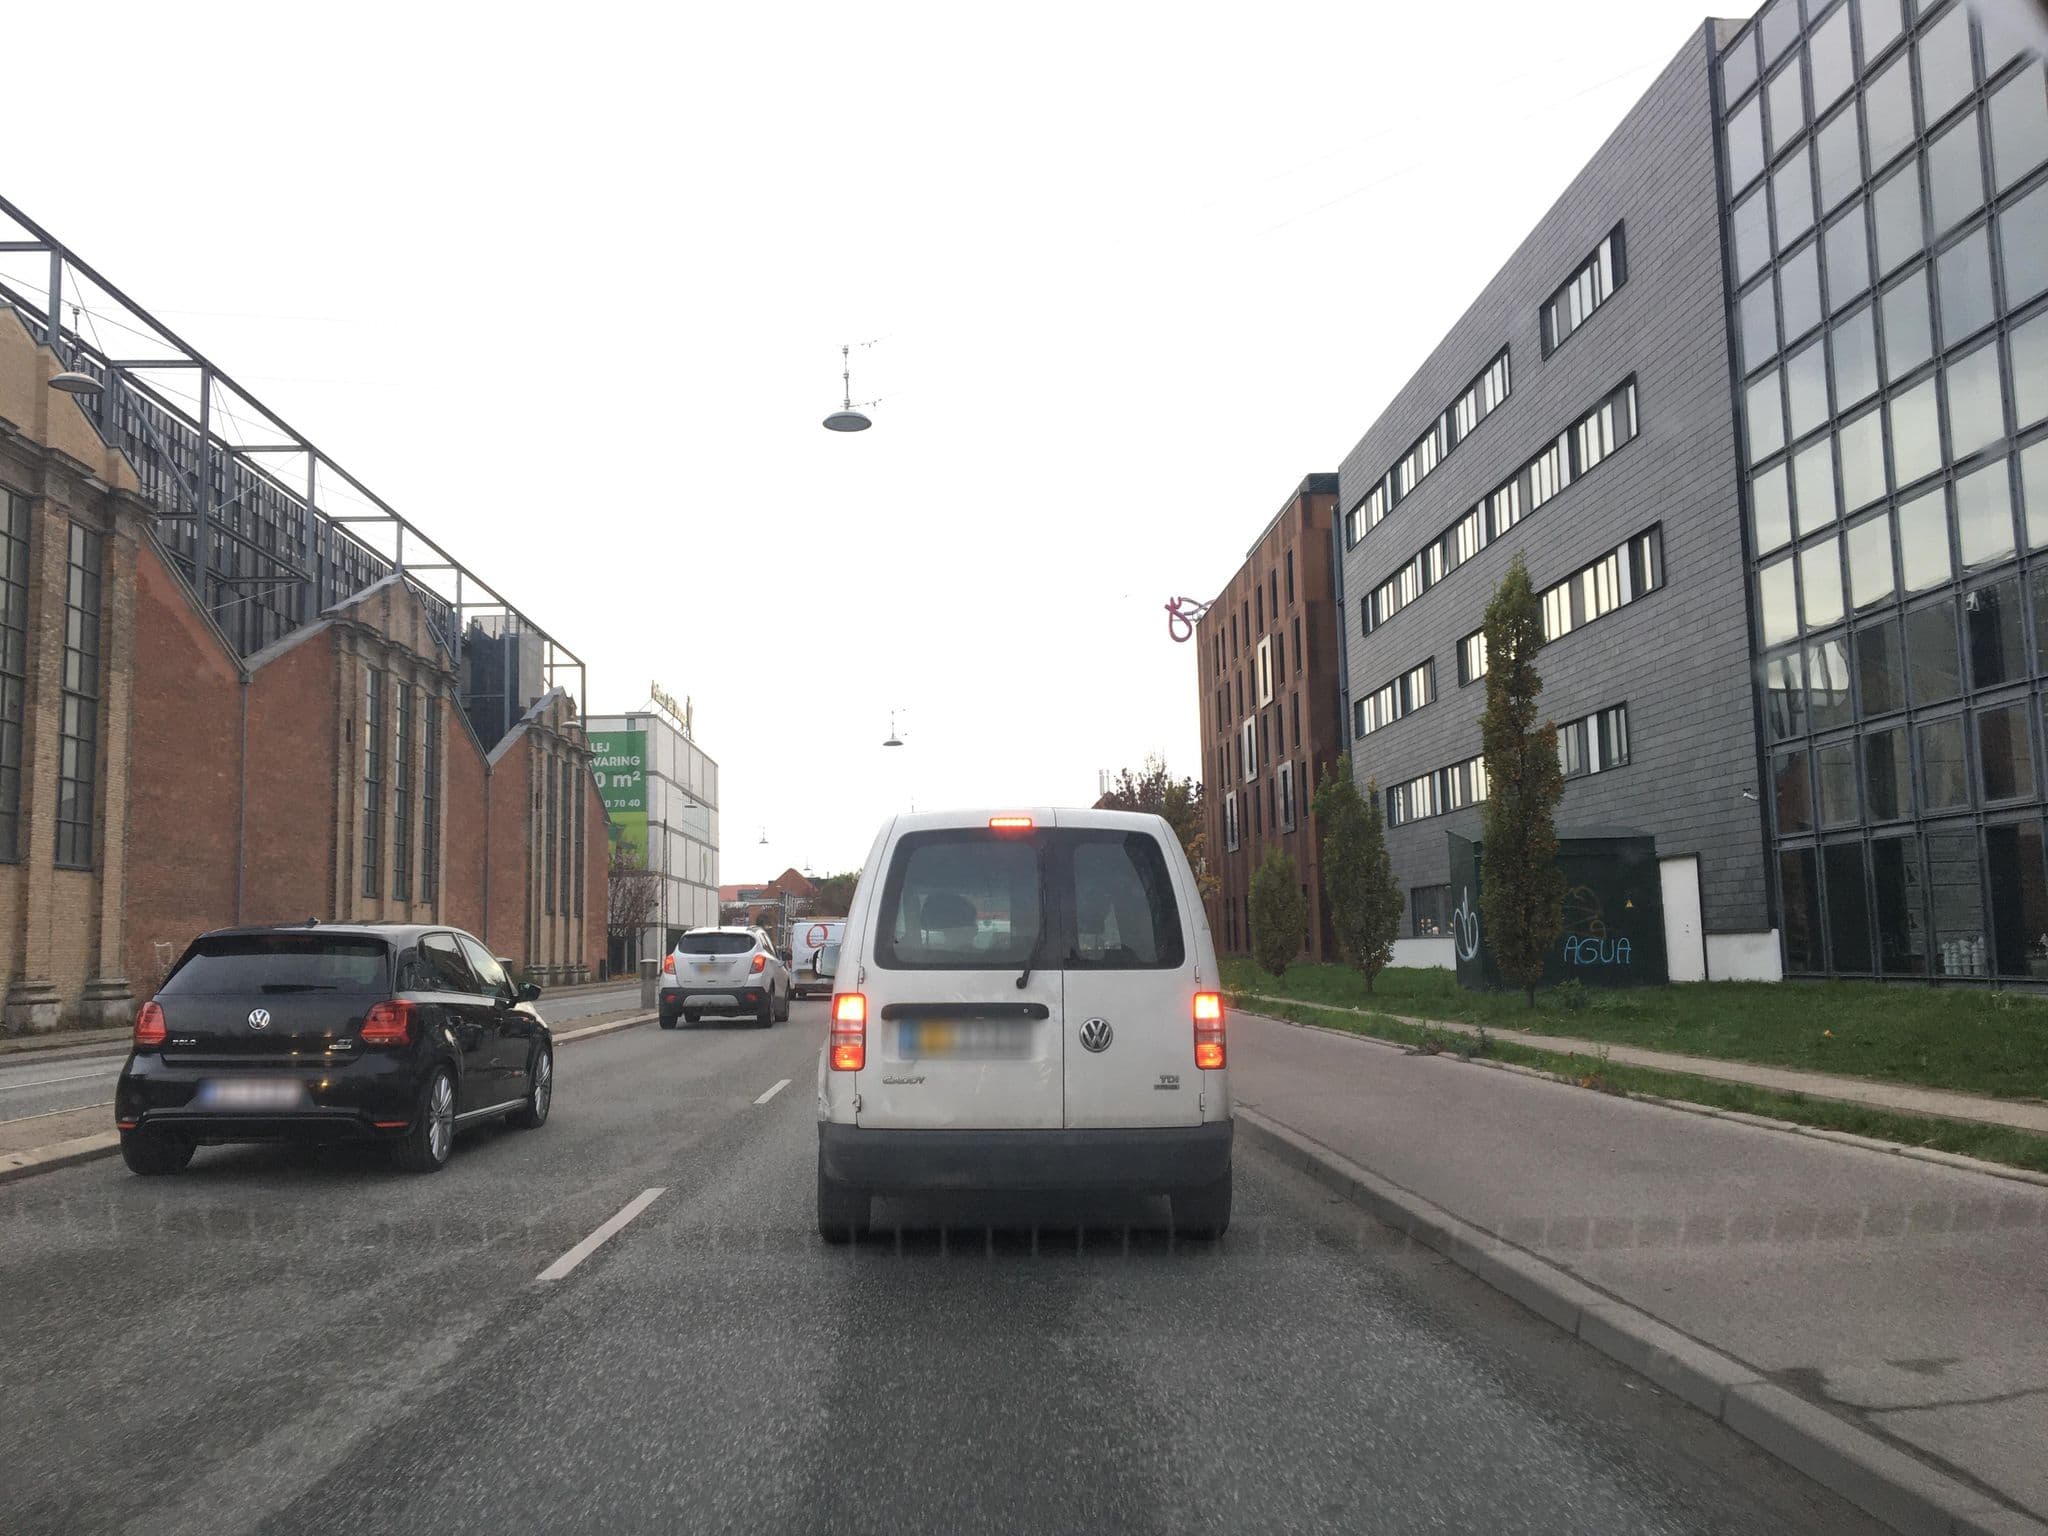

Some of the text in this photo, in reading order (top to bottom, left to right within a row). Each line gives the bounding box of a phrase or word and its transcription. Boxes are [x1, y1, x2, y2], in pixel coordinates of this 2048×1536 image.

[614, 799, 626, 808] 70
[628, 798, 641, 808] 40
[1564, 935, 1632, 965] AGUA
